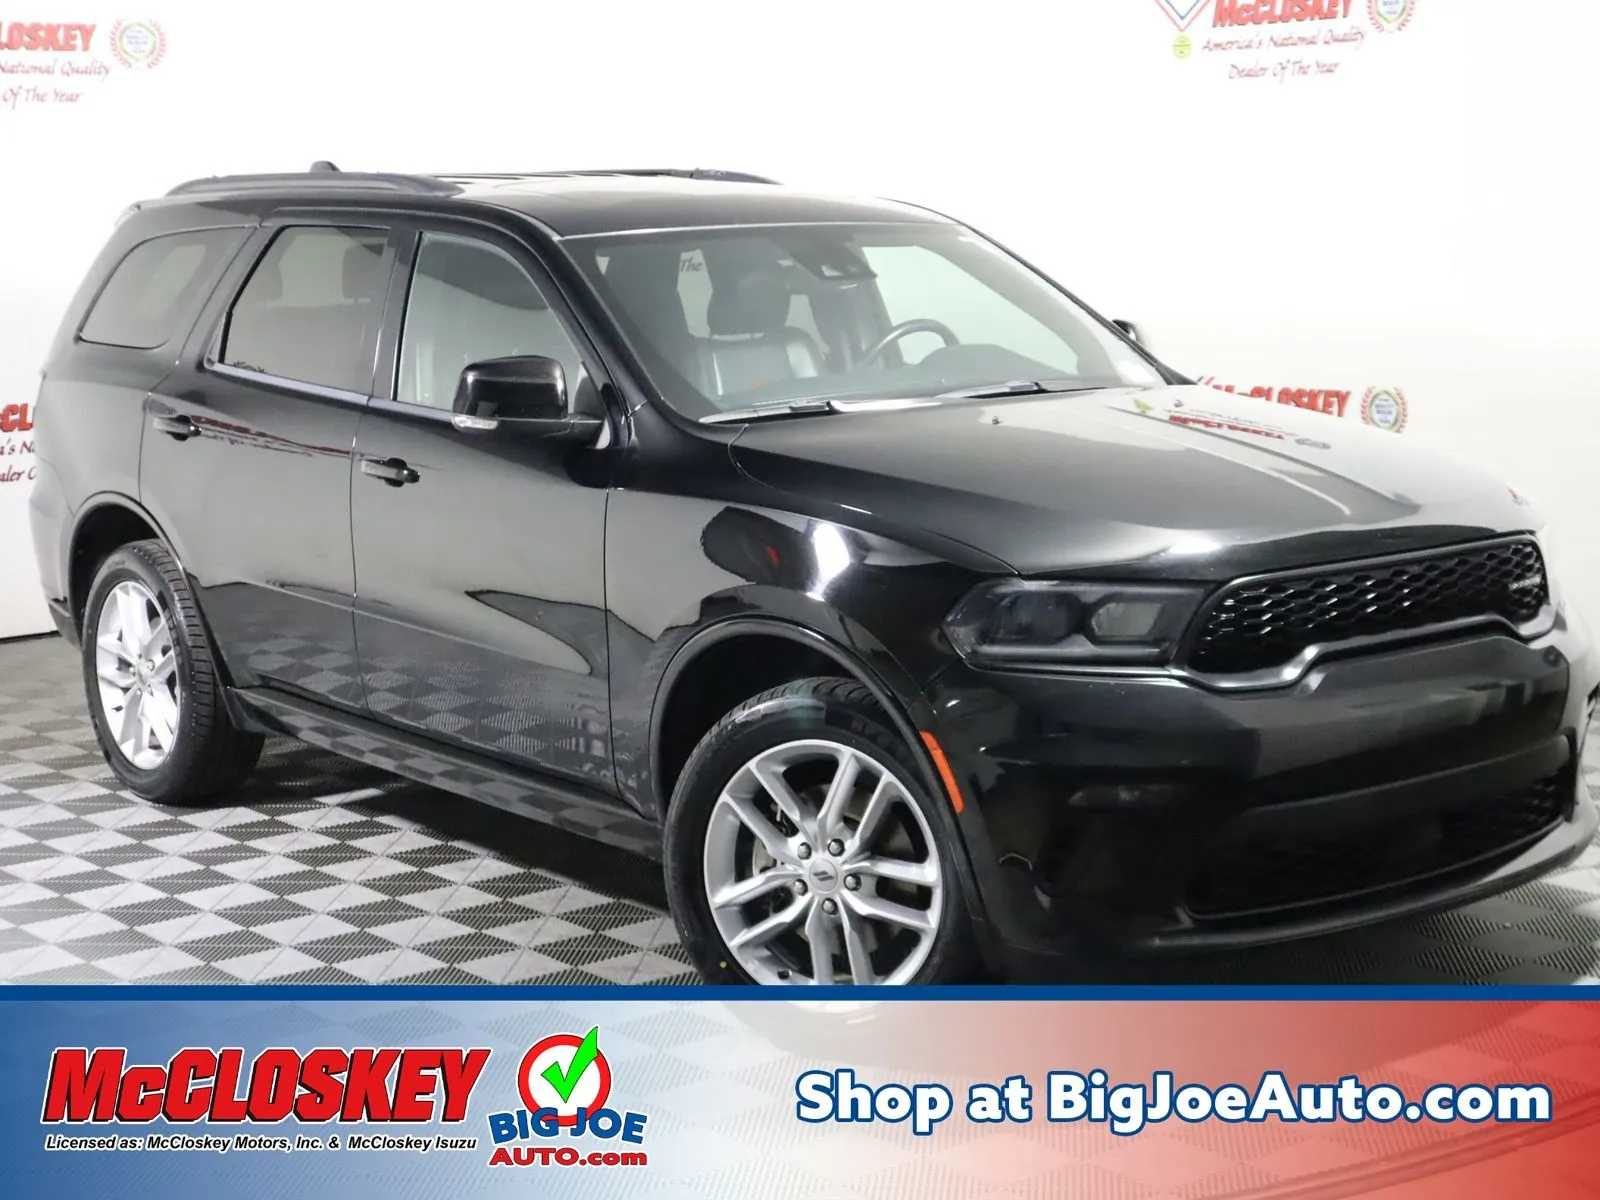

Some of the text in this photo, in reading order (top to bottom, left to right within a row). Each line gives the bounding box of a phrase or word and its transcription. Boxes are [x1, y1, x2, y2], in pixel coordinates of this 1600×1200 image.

[1267, 28, 1321, 50] National
[1323, 25, 1366, 51] Quality
[61, 59, 111, 80] Quality
[1229, 57, 1340, 84] Dealer Of The Year
[3, 85, 82, 110] Of The Year
[680, 256, 703, 273] The
